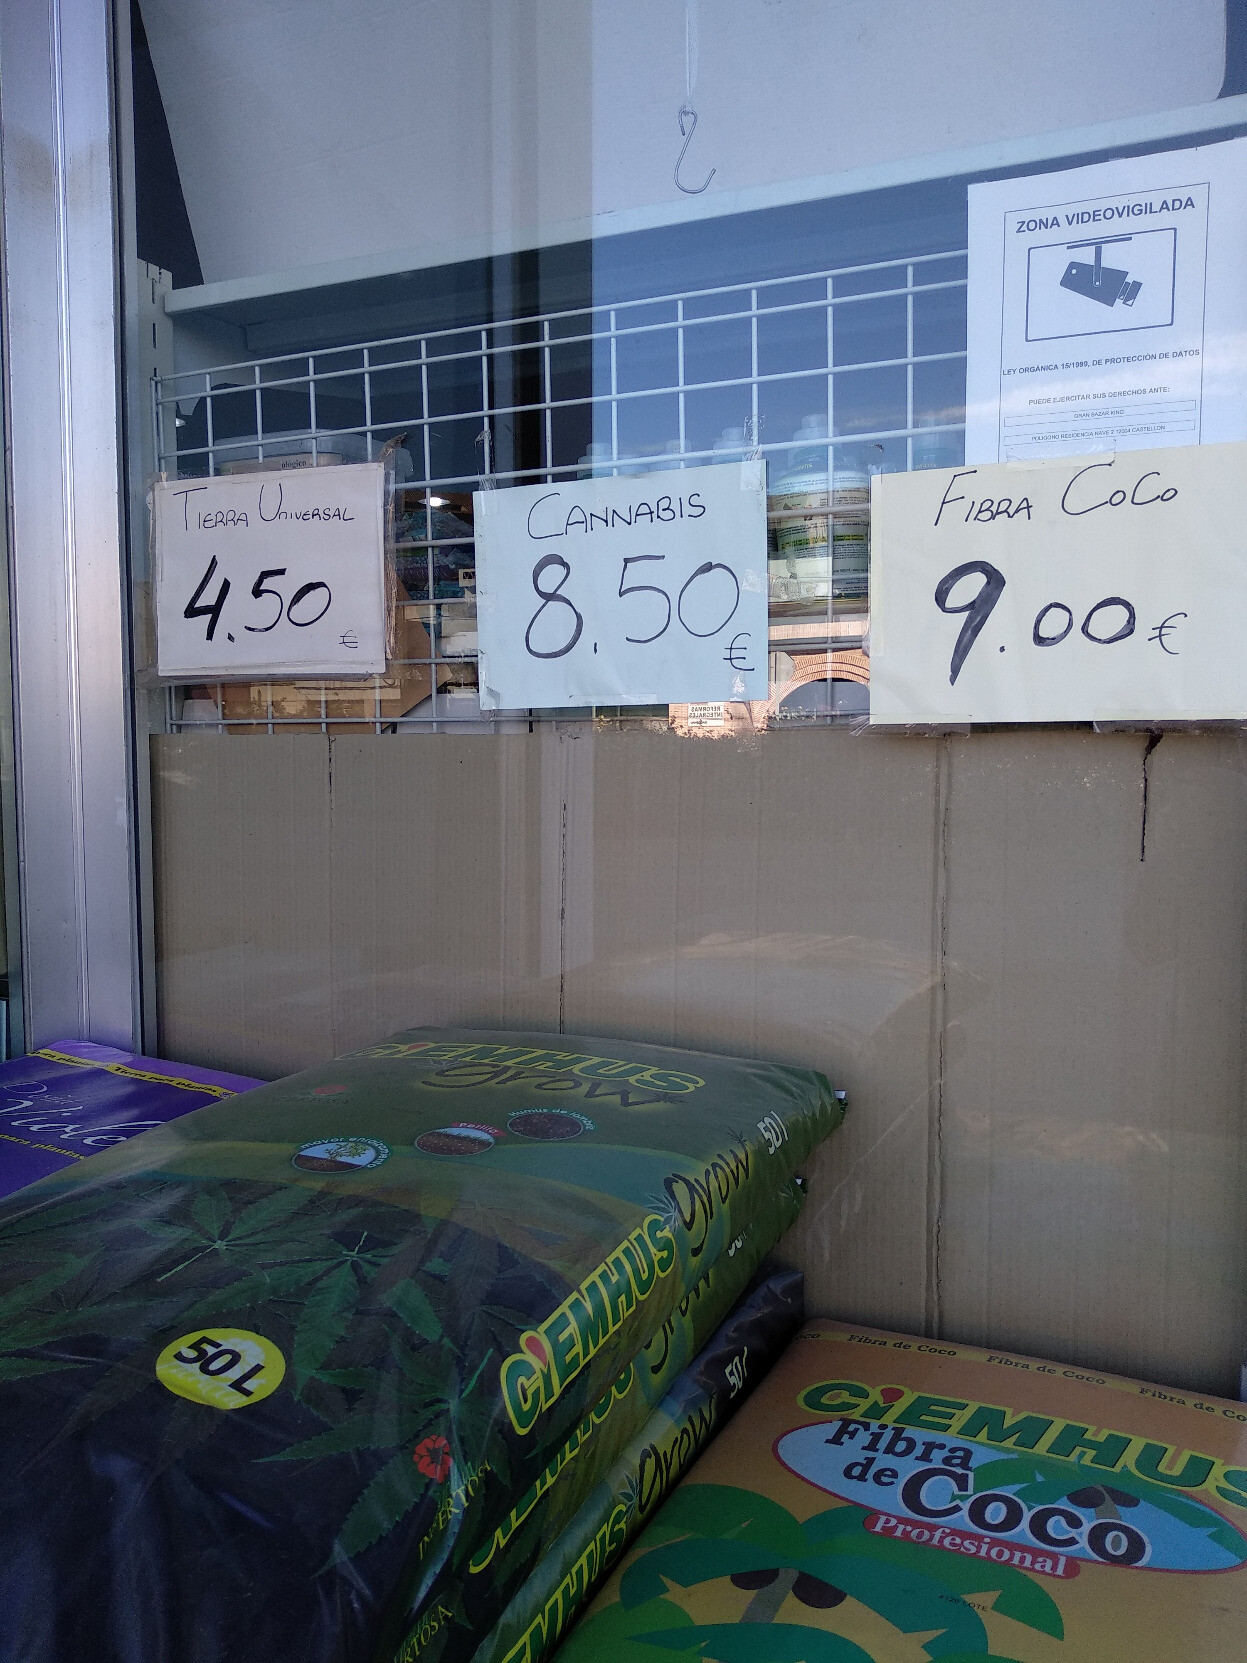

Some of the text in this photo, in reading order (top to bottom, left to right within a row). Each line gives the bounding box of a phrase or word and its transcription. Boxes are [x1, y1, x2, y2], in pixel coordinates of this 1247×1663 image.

[1015, 196, 1196, 234] ZONA VIDEOVIGILADA
[1002, 367, 1017, 376] LEY
[1018, 363, 1059, 375] ORGÁNICA
[1092, 359, 1103, 367] DE
[1105, 352, 1157, 365] PROTECCIÓN
[1158, 352, 1170, 360] DE
[1172, 349, 1200, 359] DATOS
[1028, 386, 1171, 406] PUEDE EJERCITAR SUS DERECHOS ANTE:
[172, 486, 249, 532] TIERRA
[526, 491, 707, 540] CANNABIS
[933, 469, 1034, 527] FIBRA
[183, 554, 359, 649] 4.50 €
[524, 553, 756, 672] 8.50 €
[933, 560, 1189, 687] 9.00 €
[847, 1333, 957, 1357] Fibra de Coco
[986, 1354, 1107, 1386] Fibra de Coco
[1138, 1385, 1247, 1423] Fibra de Co
[824, 1416, 975, 1473] Fibra
[842, 1455, 900, 1489] de
[898, 1465, 1153, 1570] Coco
[868, 1512, 1069, 1579] Profesional
